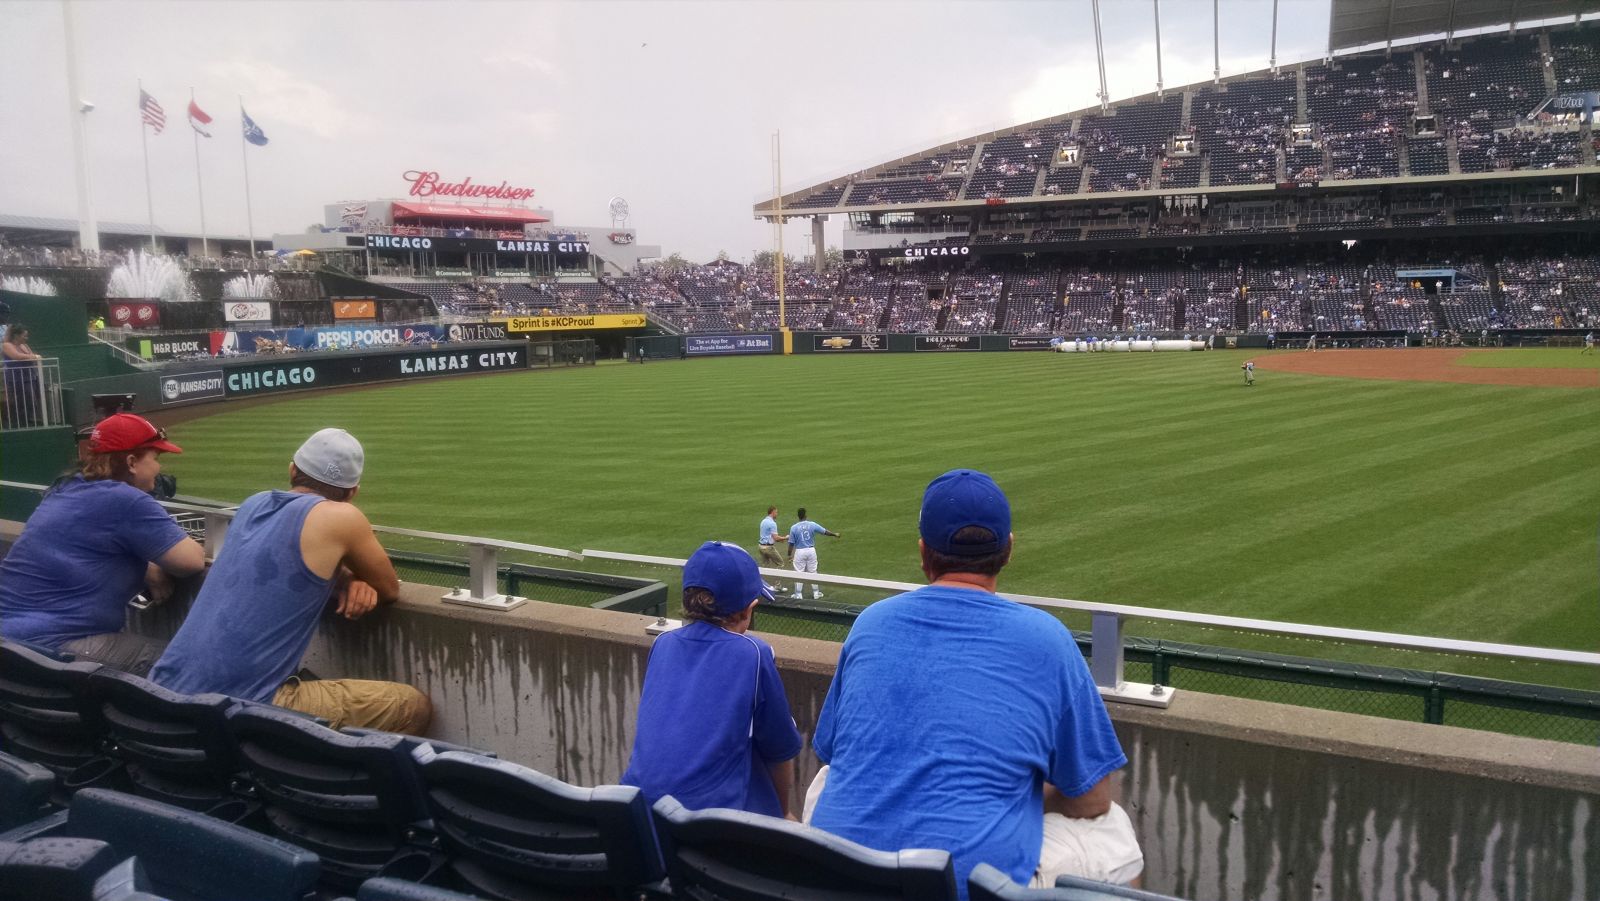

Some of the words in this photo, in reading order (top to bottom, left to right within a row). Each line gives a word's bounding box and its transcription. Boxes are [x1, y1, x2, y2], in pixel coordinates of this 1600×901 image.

[403, 170, 535, 200] Budweiser
[496, 240, 550, 252] KANSAS
[558, 242, 590, 253] CITY
[905, 247, 969, 256] CHICAGO
[513, 319, 539, 330] Sprint
[542, 318, 550, 327] is
[551, 317, 595, 327] #KCProud
[318, 331, 351, 348] PEPSI
[355, 329, 399, 345] PORCH
[153, 343, 171, 354] H&R
[172, 341, 199, 353] BLOCK
[401, 355, 469, 374] KANSAS
[479, 352, 518, 367] CITY
[180, 382, 206, 393] KANSAS
[207, 378, 222, 390] CITY
[228, 367, 316, 391] CHICAGO
[166, 384, 177, 392] FOX
